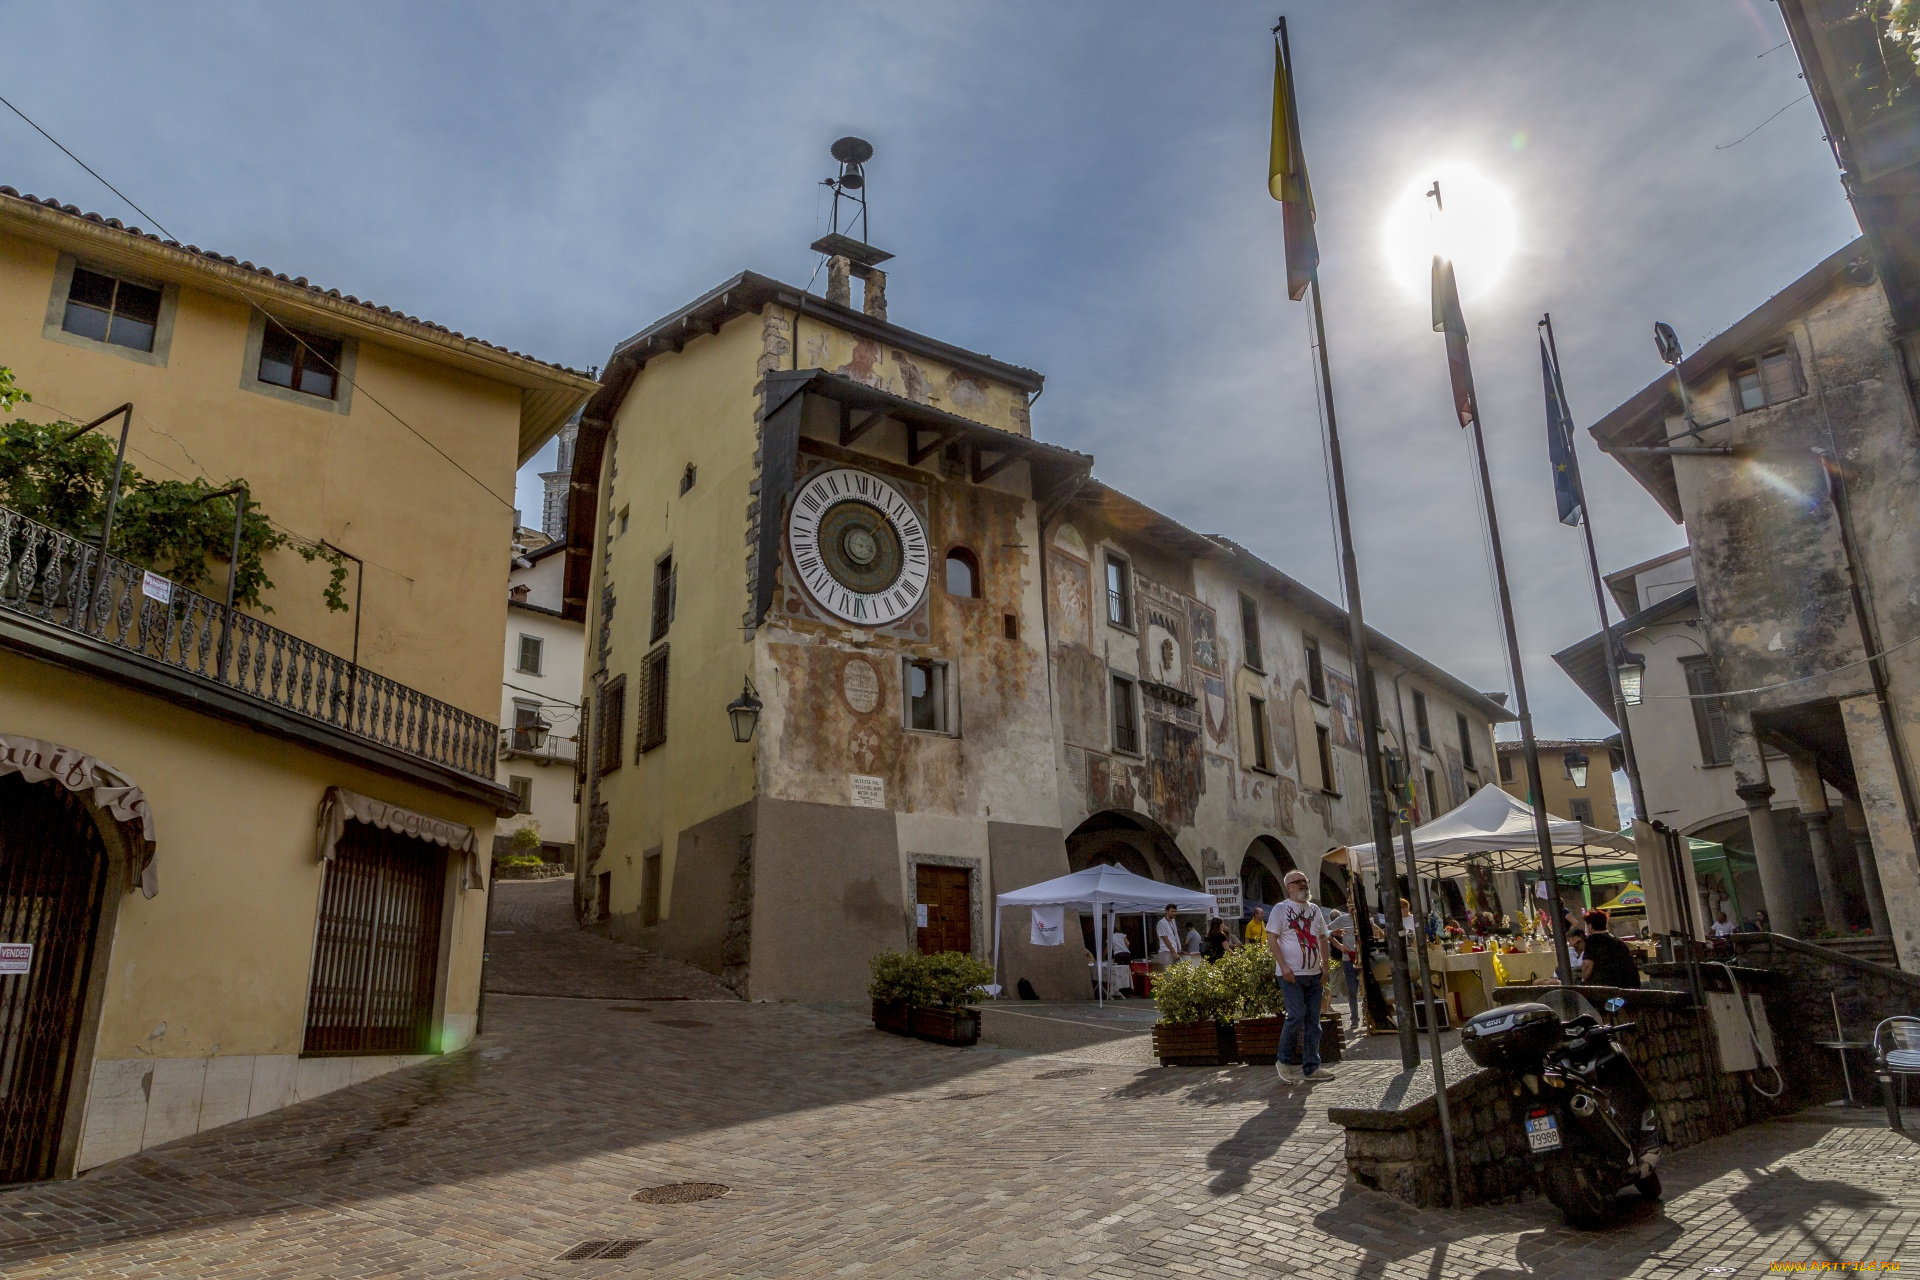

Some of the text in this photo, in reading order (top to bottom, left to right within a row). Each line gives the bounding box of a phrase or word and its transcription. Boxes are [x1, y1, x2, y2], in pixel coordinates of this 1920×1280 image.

[812, 482, 829, 503] III
[826, 476, 839, 495] II
[854, 474, 868, 495] XII
[870, 480, 883, 501] XI
[883, 491, 897, 509] X
[1208, 878, 1239, 886] VENDIAMO
[1216, 896, 1237, 904] CCOLTI
[1530, 1130, 1558, 1147] 79988
